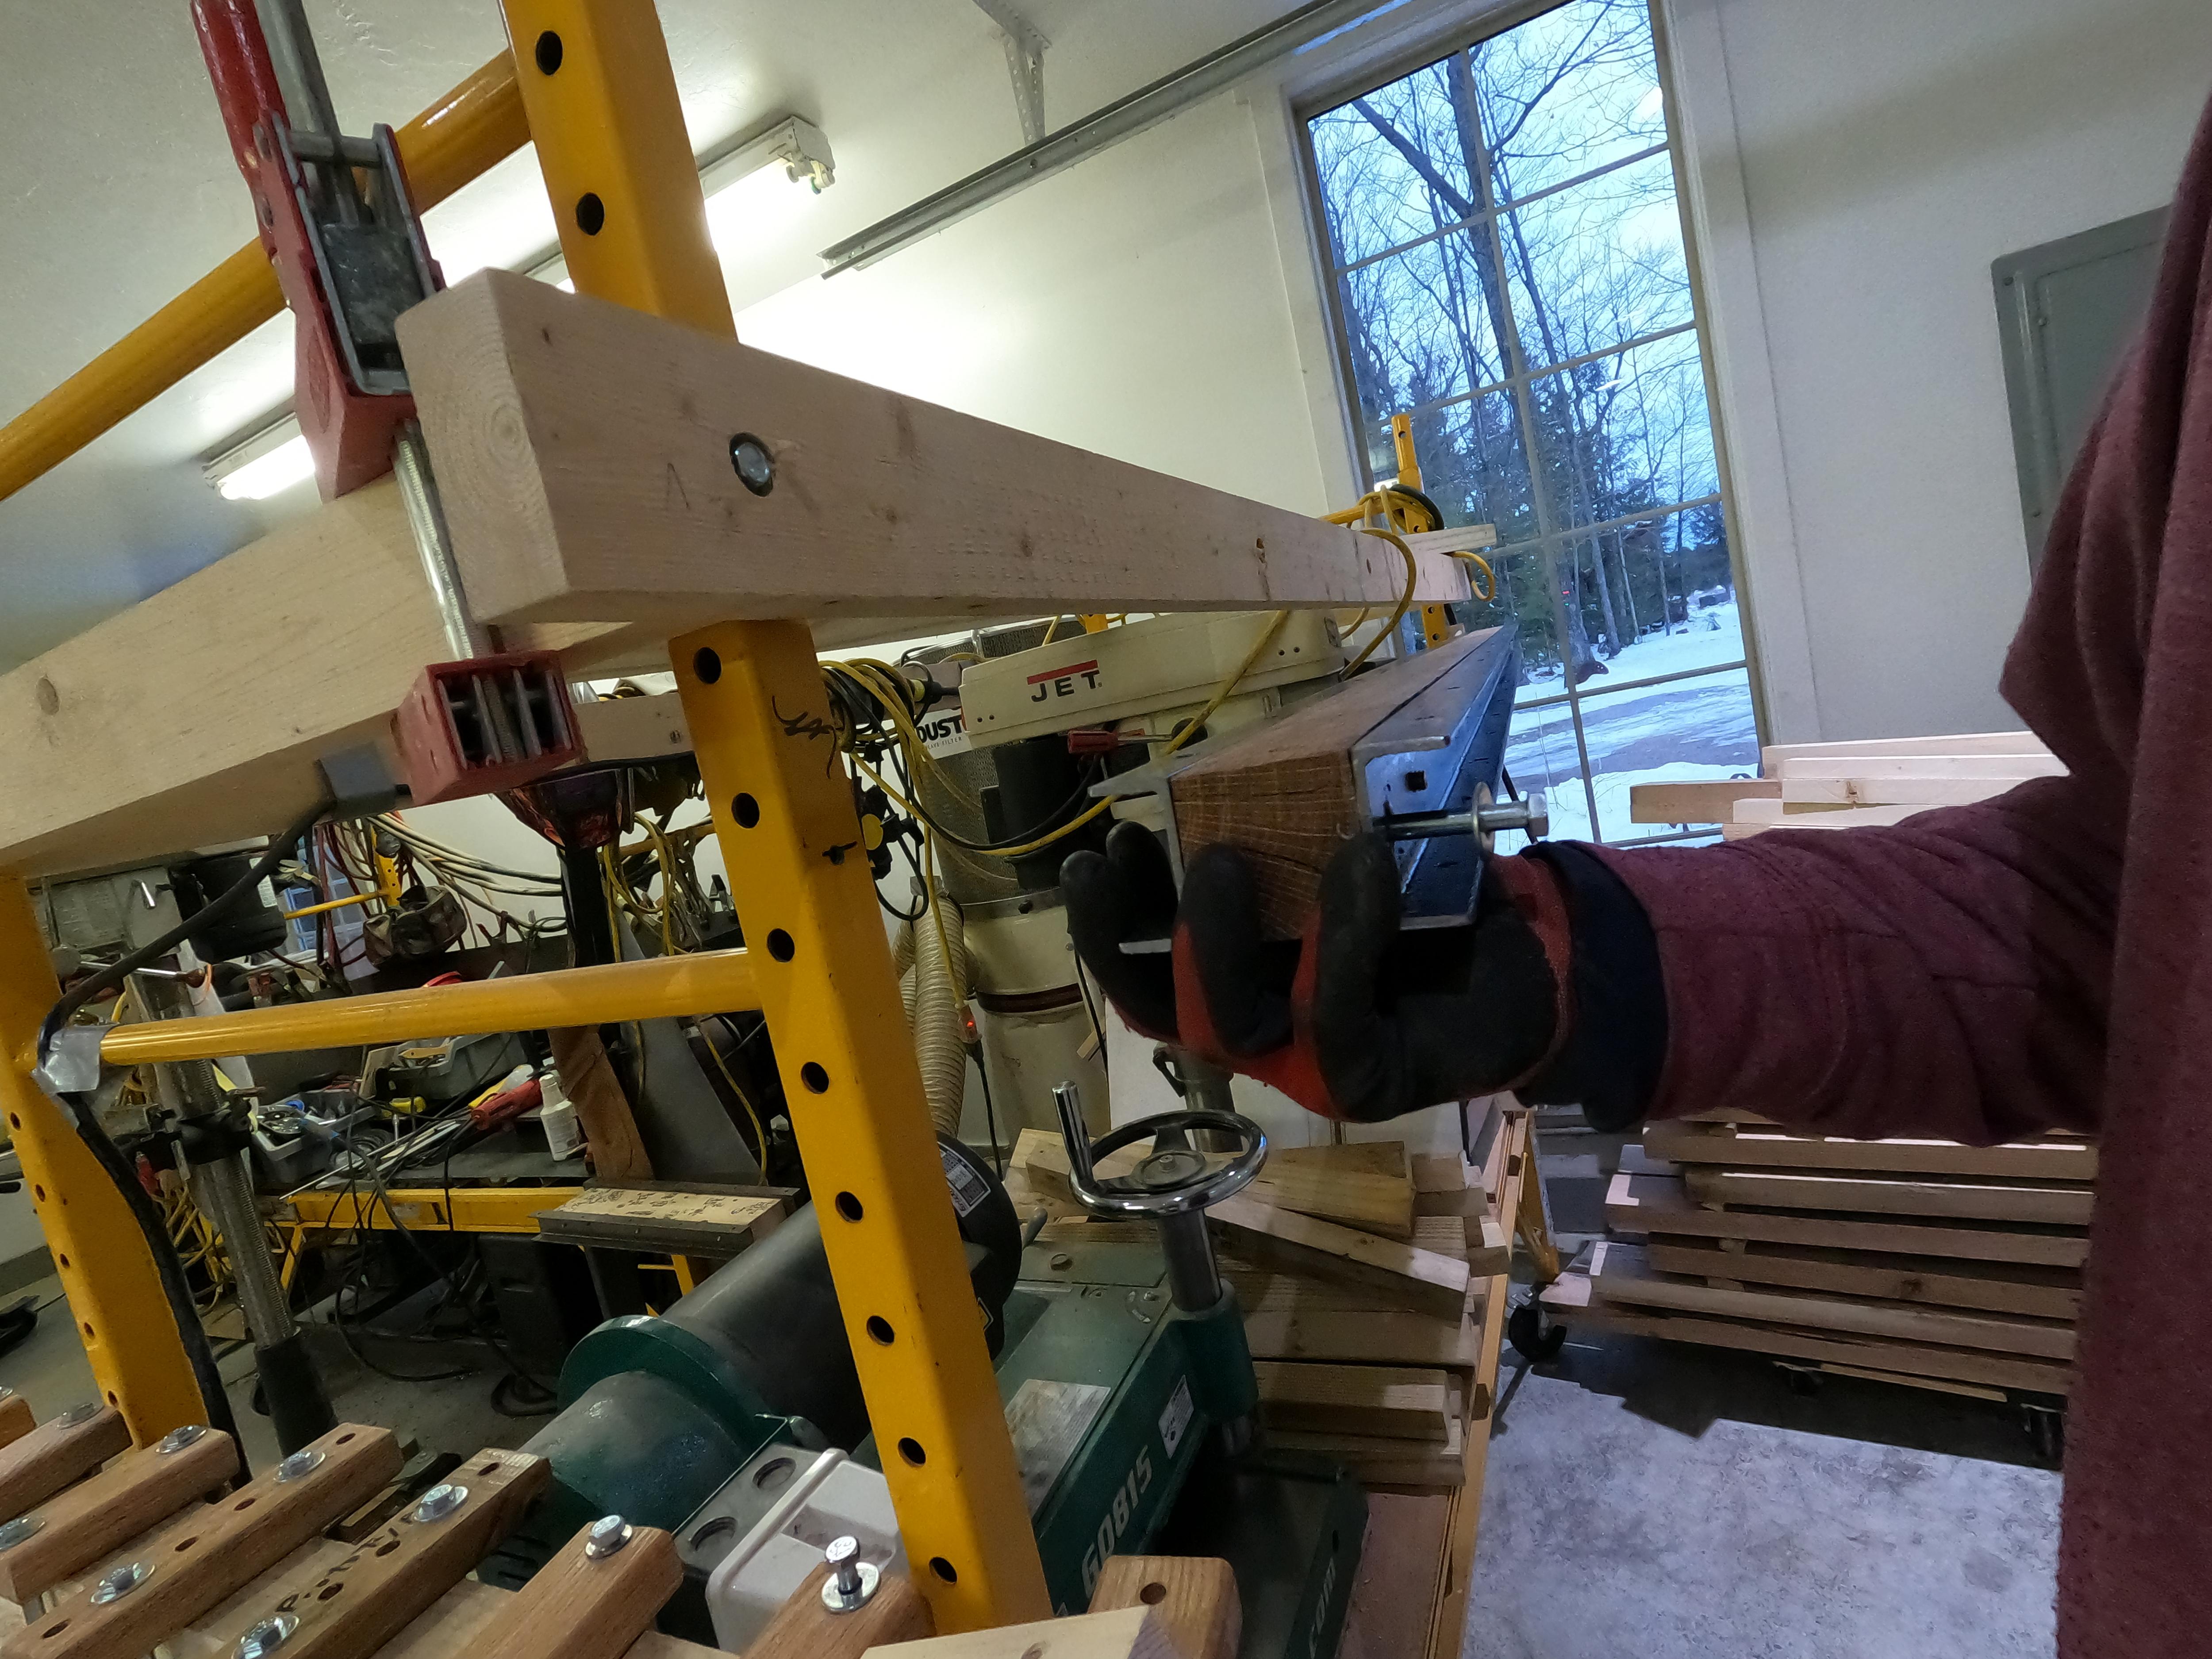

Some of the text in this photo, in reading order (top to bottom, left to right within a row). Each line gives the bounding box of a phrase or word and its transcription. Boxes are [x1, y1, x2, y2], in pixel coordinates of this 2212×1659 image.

[1031, 669, 1100, 702] JET
[916, 714, 963, 743] DUST
[942, 736, 962, 745] FILTER
